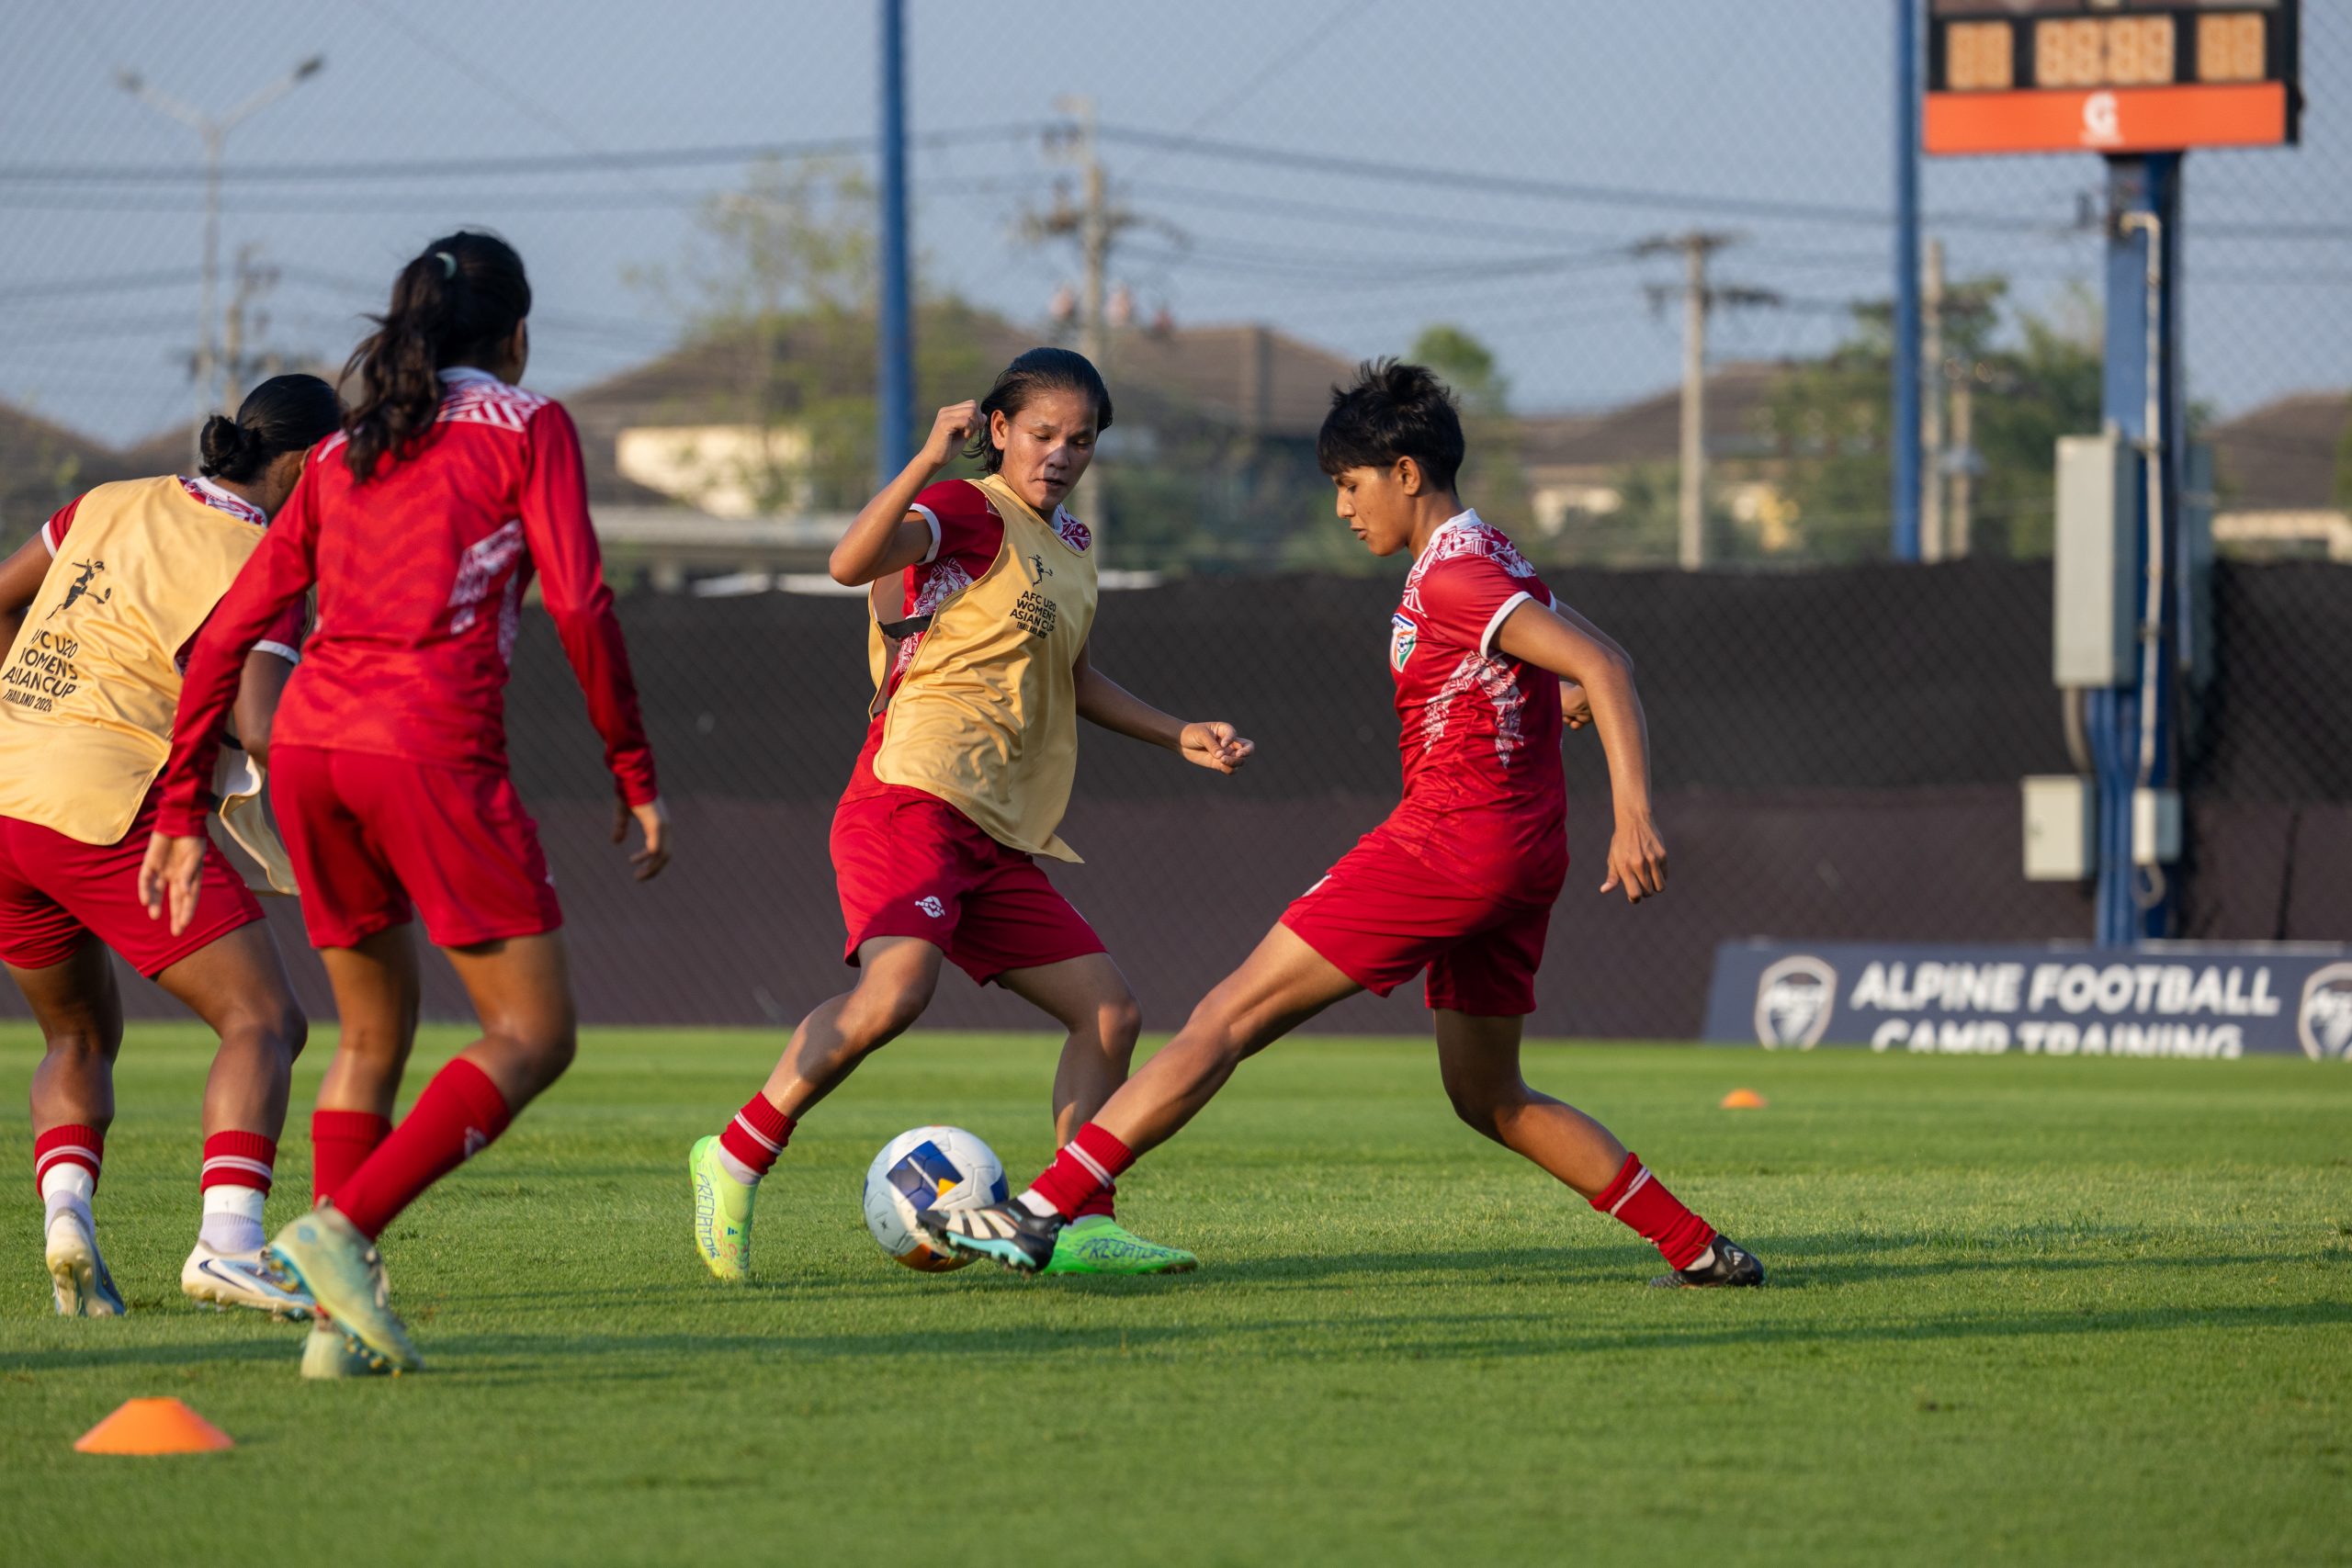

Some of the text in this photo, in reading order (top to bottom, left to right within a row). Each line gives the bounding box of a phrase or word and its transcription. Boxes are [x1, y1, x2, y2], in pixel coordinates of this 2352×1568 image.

[1016, 598, 1057, 623] WOMEN'S
[1022, 591, 1057, 612] AFC U20
[1009, 608, 1041, 626] ASIAN
[55, 635, 78, 659] U20
[42, 676, 76, 699] CUP
[1849, 961, 2026, 1012] ALPINE
[2029, 963, 2281, 1016] FOOTBALL
[2017, 1021, 2243, 1059] TRAINING
